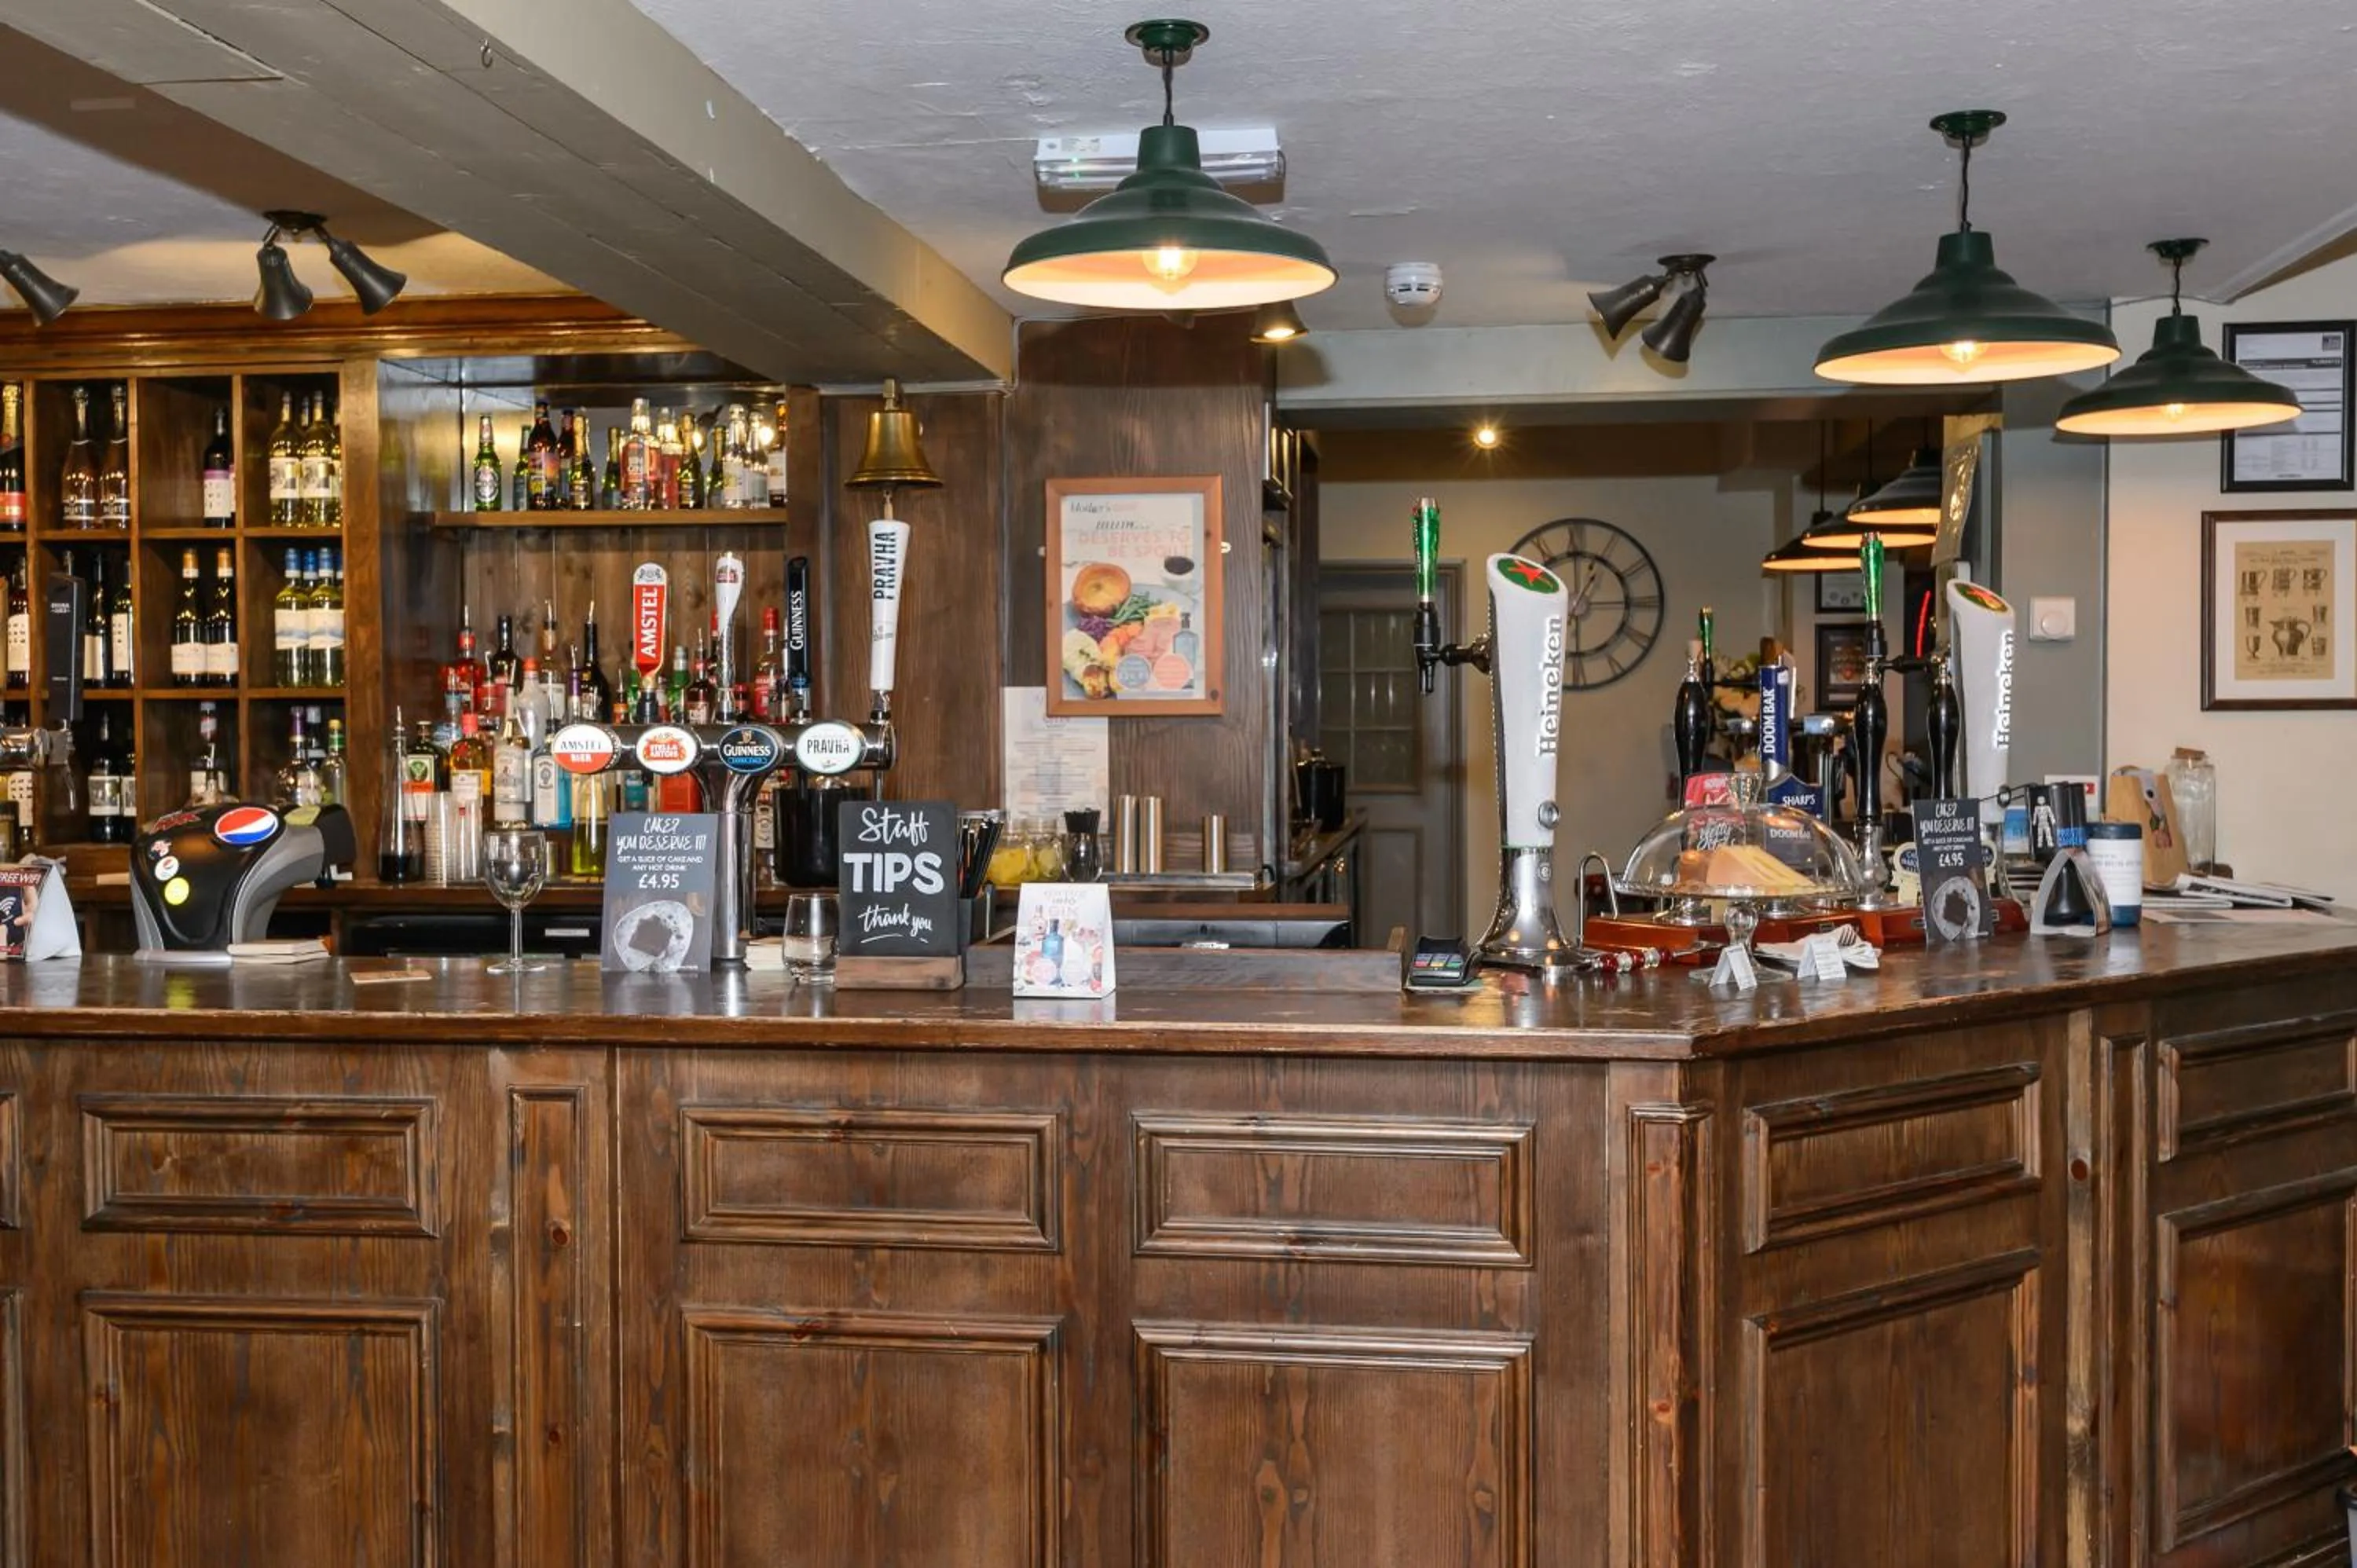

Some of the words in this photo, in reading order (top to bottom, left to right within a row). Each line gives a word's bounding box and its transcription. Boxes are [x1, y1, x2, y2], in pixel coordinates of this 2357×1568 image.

[873, 532, 896, 600] PRAVHA
[640, 588, 658, 658] AMSTEL
[790, 590, 805, 650] GUINNESS
[1536, 615, 1563, 757] Heineken
[1762, 687, 1776, 714] BAR
[1993, 630, 2014, 749] Heineken
[724, 745, 772, 757] GUINNESS
[807, 738, 850, 754] PRAVHA
[1762, 716, 1776, 753] DOOM
[1781, 793, 1816, 806] SHARP'S
[644, 817, 680, 834] CAKE?
[858, 807, 930, 847] Staff
[616, 835, 637, 855] YOU
[639, 835, 692, 850] DESERVE
[1939, 852, 1964, 867] £4.95
[639, 873, 680, 888] £4.95
[843, 852, 944, 895] TIPS
[857, 903, 911, 932] thank
[911, 918, 933, 937] you
